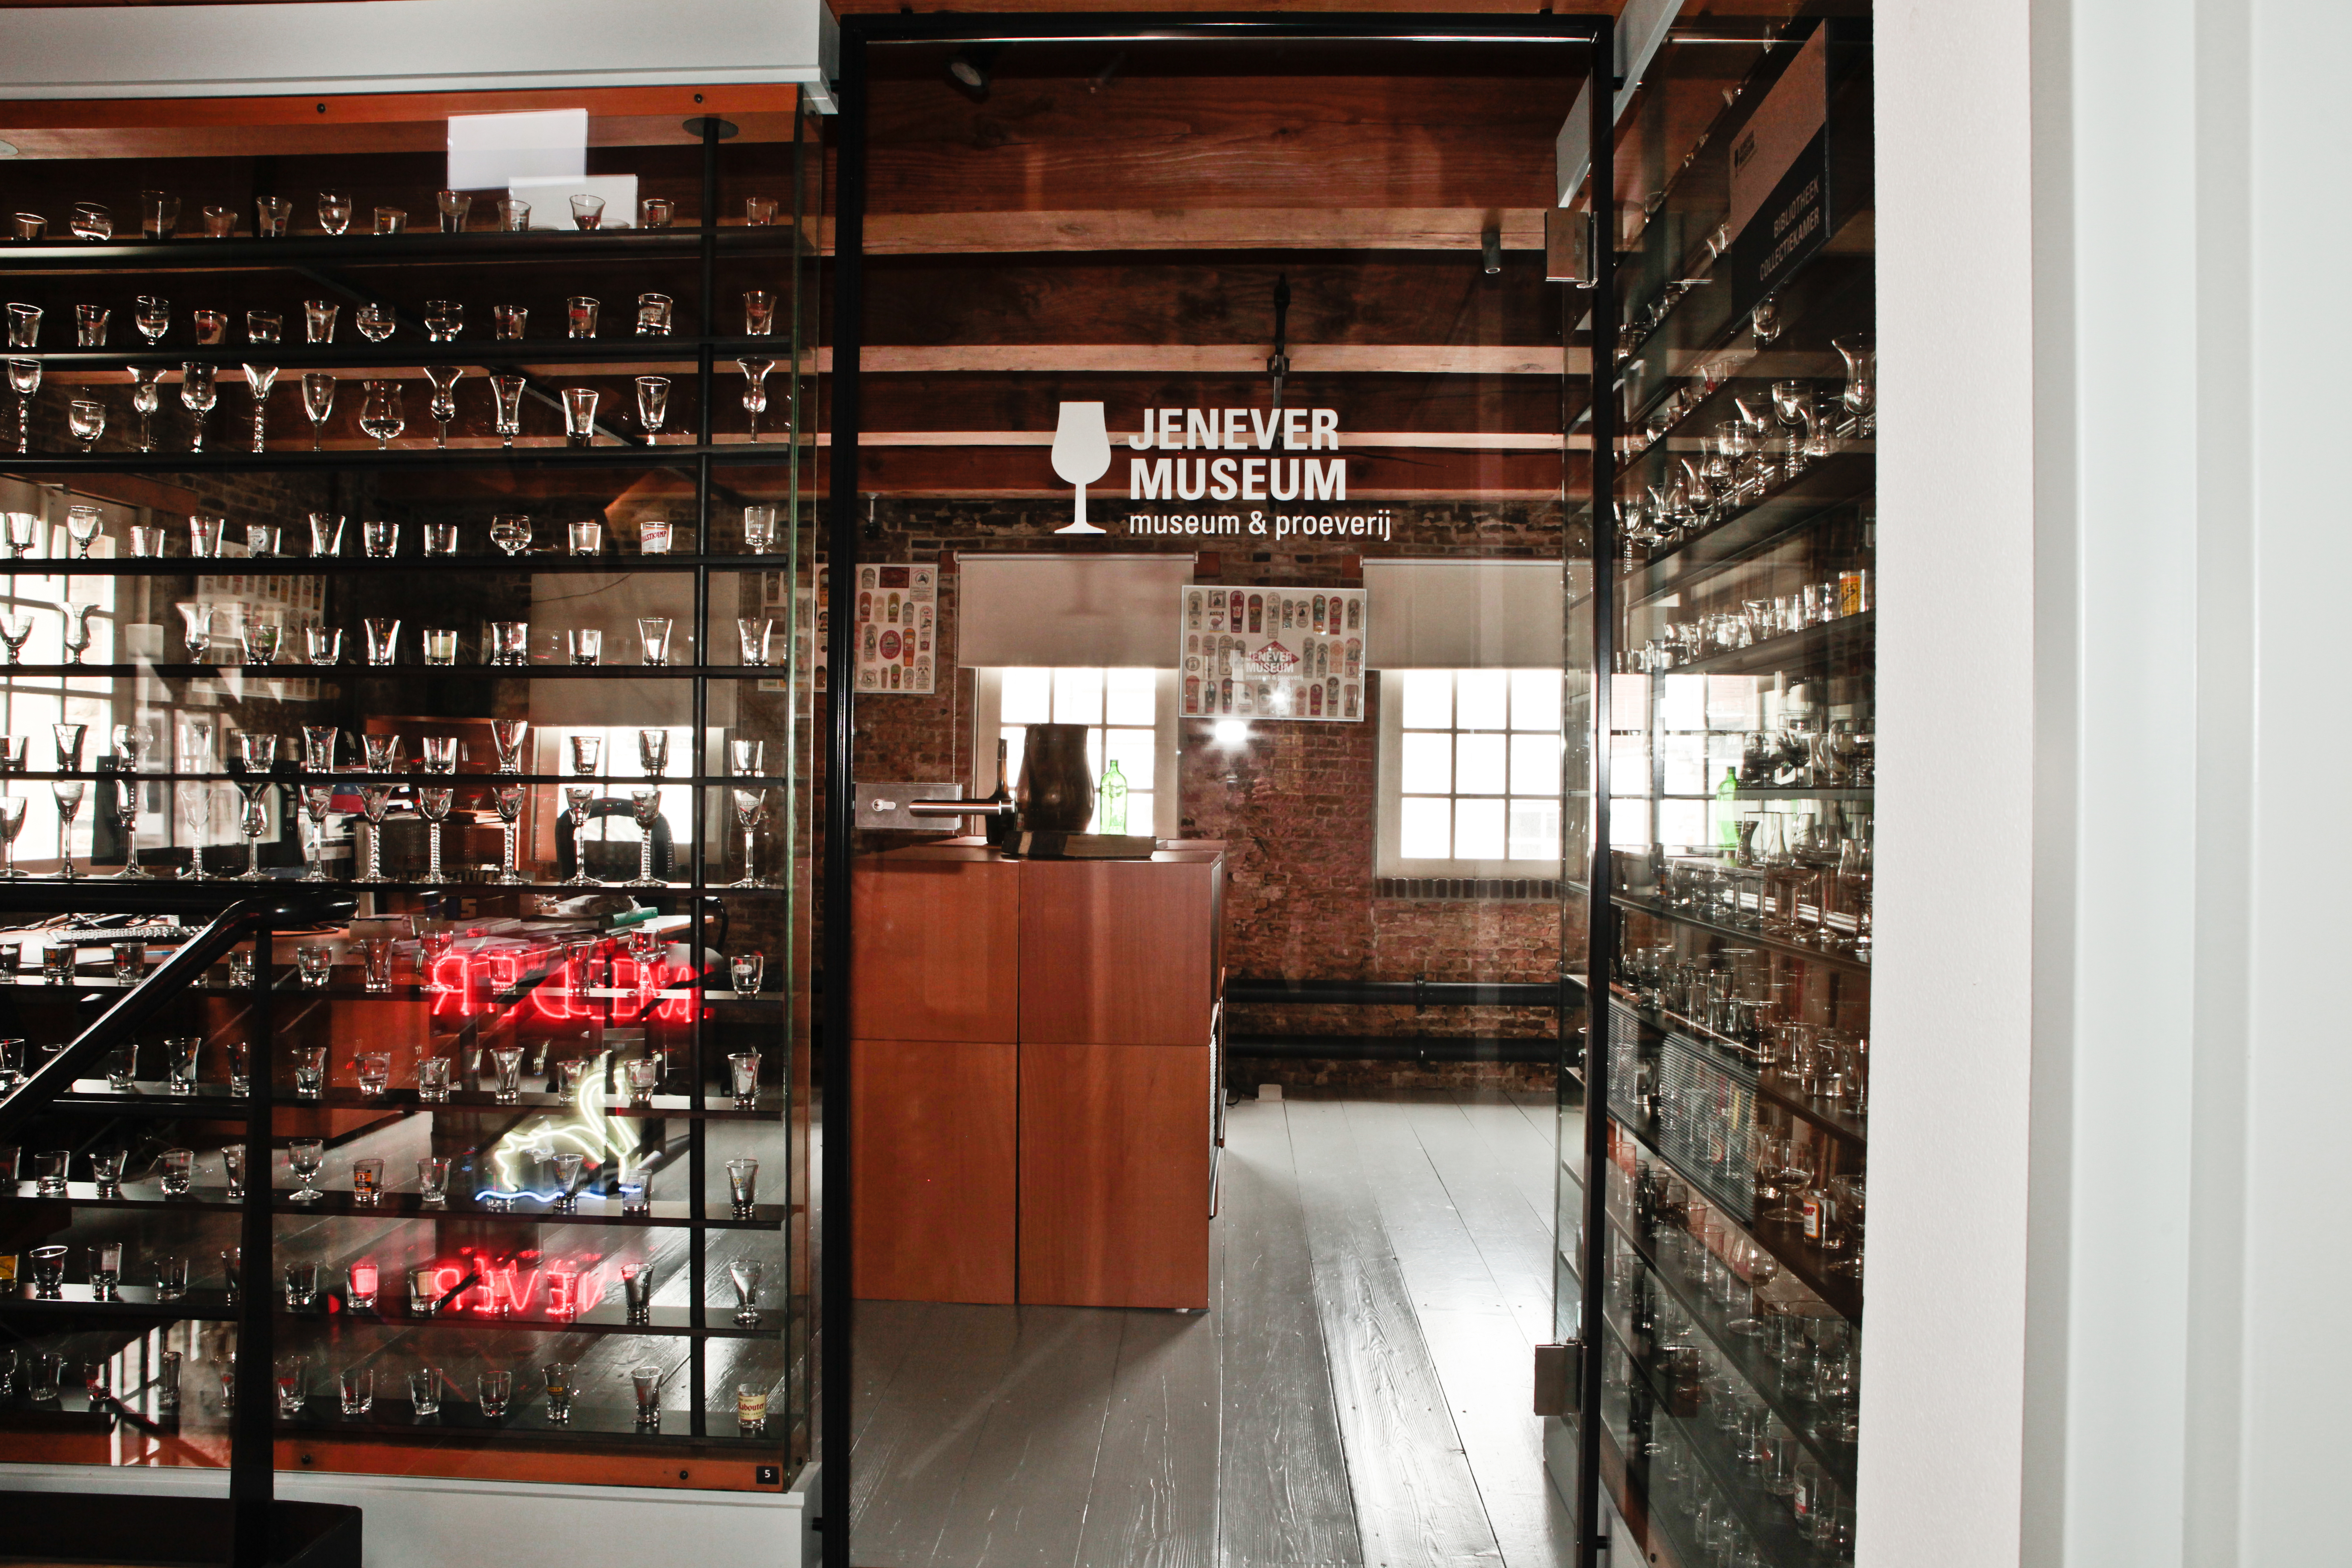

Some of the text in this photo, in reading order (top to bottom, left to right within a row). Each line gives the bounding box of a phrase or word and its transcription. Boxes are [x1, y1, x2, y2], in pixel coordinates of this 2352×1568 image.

[1774, 175, 1819, 238] BIBLIOTHEEK
[1760, 207, 1819, 281] COLLECTIEKAMER
[1128, 408, 1339, 450] JENEVER
[1130, 458, 1346, 501] MUSEUM
[1130, 510, 1391, 541] museum & proeverij
[1246, 662, 1294, 673] MUSEUM
[765, 1470, 771, 1478] 5
